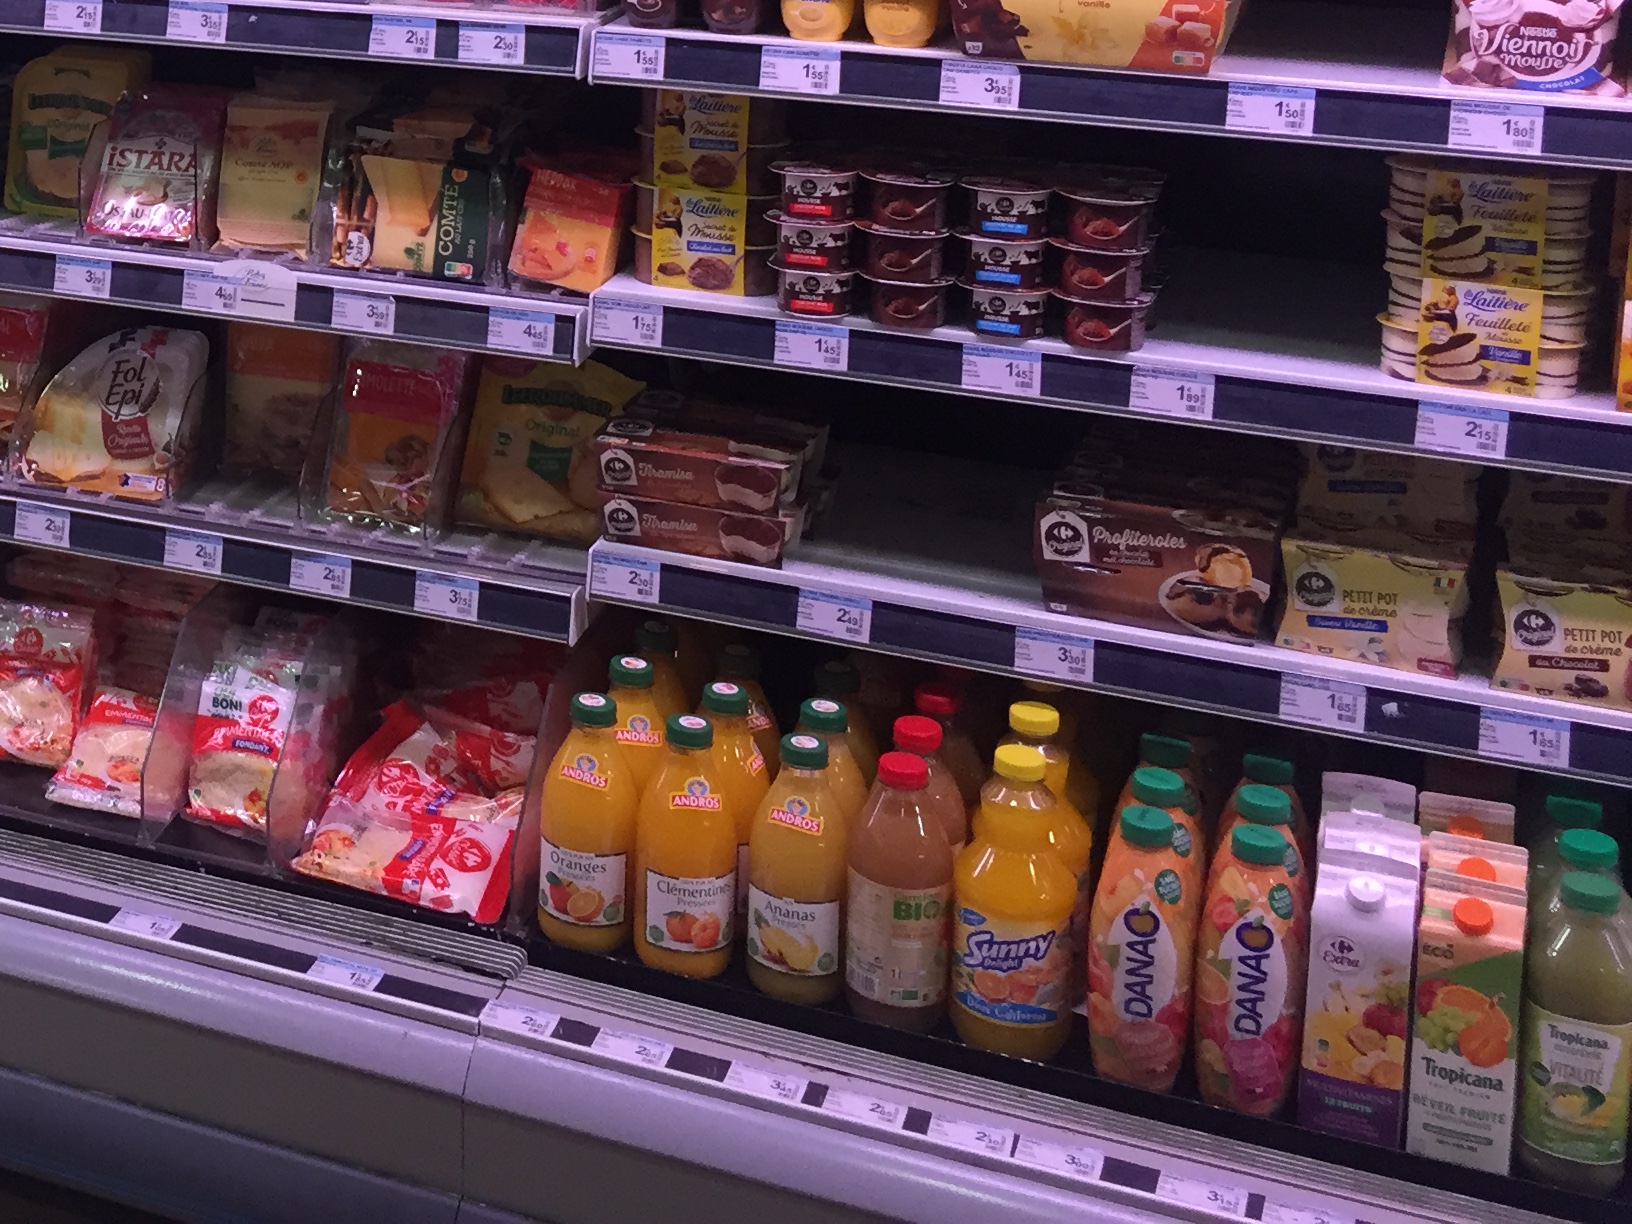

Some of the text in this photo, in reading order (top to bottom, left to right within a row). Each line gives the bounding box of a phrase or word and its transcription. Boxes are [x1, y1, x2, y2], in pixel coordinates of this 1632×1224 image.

[1078, 0, 1111, 9] vanille
[439, 185, 459, 255] COMTÉ
[111, 356, 147, 383] Fol
[105, 383, 143, 420] Epi
[1092, 526, 1187, 551] Profiteroles
[1342, 590, 1400, 607] PETIT POT
[1563, 627, 1623, 645] PETIT POT
[561, 766, 608, 789] ANDROS
[672, 794, 721, 810] ANDROS
[771, 807, 822, 833] ANDROS
[549, 851, 607, 875] Oranges
[765, 899, 816, 924] Ananas
[966, 930, 1056, 965] Sunny
[1125, 907, 1161, 1018] DANAO
[1234, 920, 1275, 1036] DANAO
[1547, 1024, 1610, 1050] Tropicana
[1421, 1057, 1504, 1092] Tropicana
